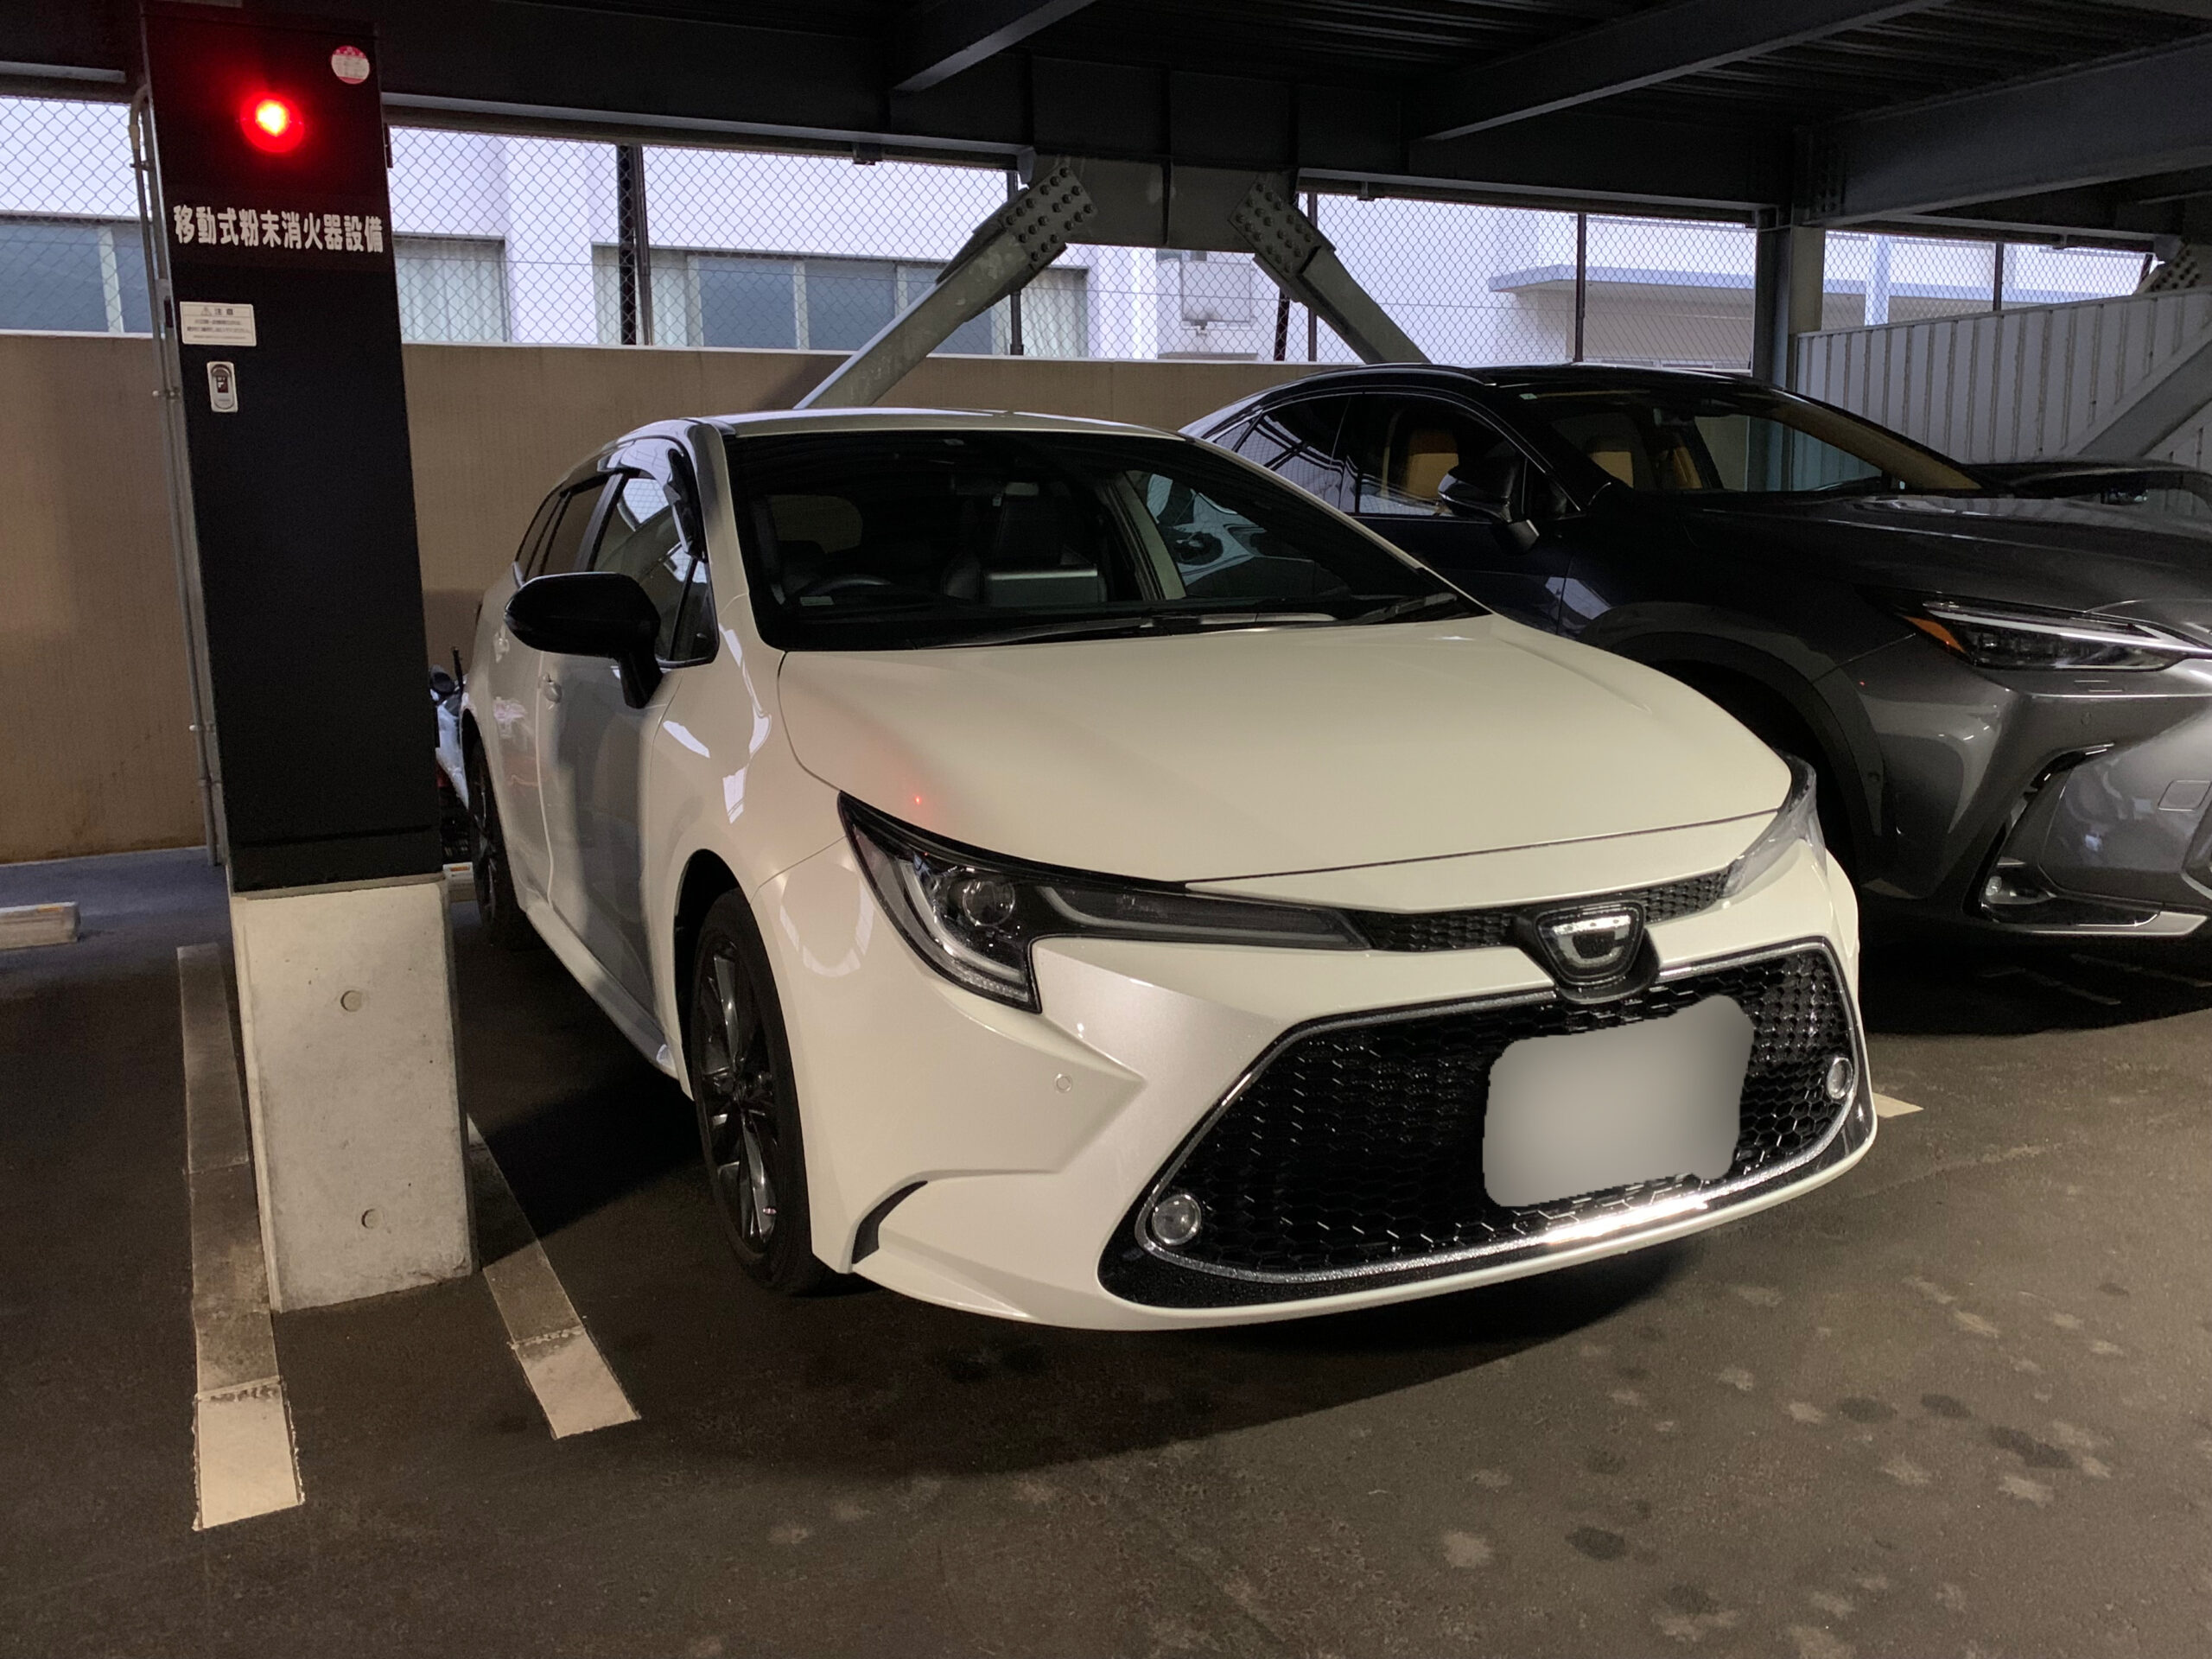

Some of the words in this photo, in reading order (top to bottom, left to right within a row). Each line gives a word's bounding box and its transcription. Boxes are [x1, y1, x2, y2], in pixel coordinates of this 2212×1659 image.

[173, 204, 384, 253] 移動式粉末消火器設備
